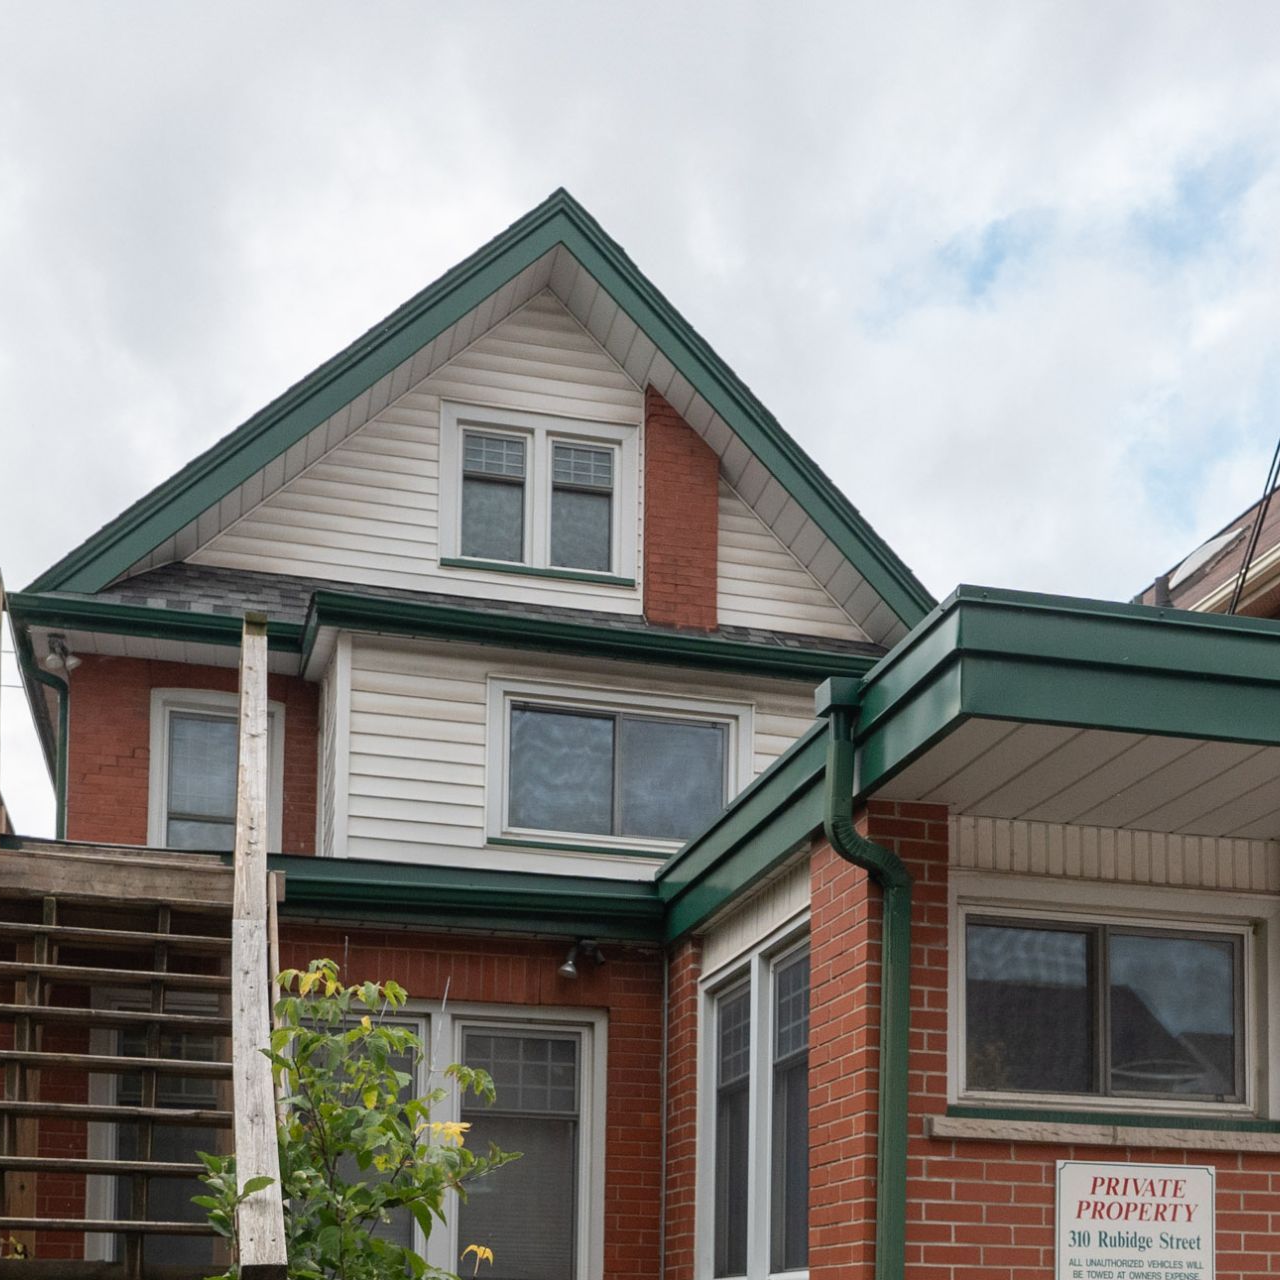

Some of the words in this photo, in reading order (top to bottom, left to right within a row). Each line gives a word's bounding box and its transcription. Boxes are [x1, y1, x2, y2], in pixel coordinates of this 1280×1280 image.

[1090, 1176, 1187, 1198] PRIVATE
[1076, 1200, 1198, 1222] PROPERTY
[1068, 1230, 1091, 1248] 310
[1098, 1230, 1153, 1252] Rubidge
[1159, 1232, 1202, 1250] Street
[1069, 1258, 1083, 1267] ALL
[1085, 1258, 1144, 1269] UNAUTHORIZED
[1147, 1260, 1183, 1269] VEHICLES
[1186, 1261, 1204, 1270] WILL
[1072, 1270, 1084, 1279] BE
[1086, 1270, 1114, 1279] TOWED
[1117, 1271, 1126, 1279] AT
[1129, 1271, 1161, 1280] OWNERS
